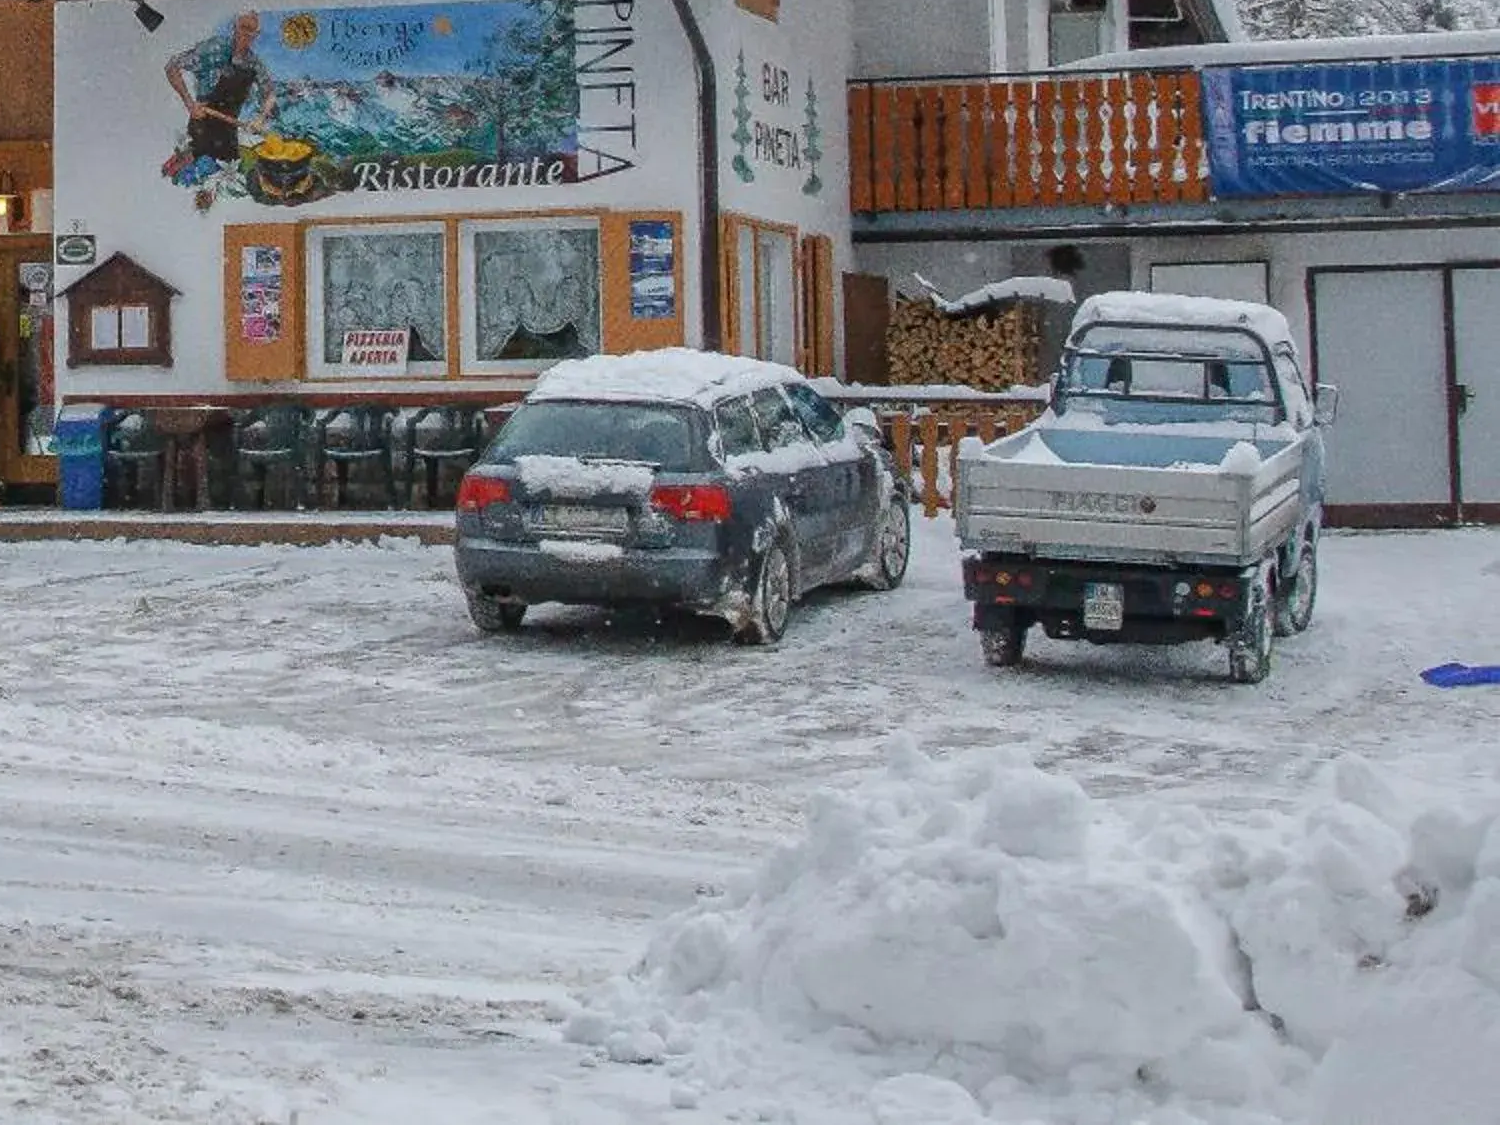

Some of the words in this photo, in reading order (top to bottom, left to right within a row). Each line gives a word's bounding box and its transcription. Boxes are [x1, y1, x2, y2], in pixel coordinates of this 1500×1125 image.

[762, 62, 789, 106] BAR
[1359, 88, 1432, 107] 2013
[755, 121, 800, 169] PINETA
[353, 156, 565, 192] Ristorante
